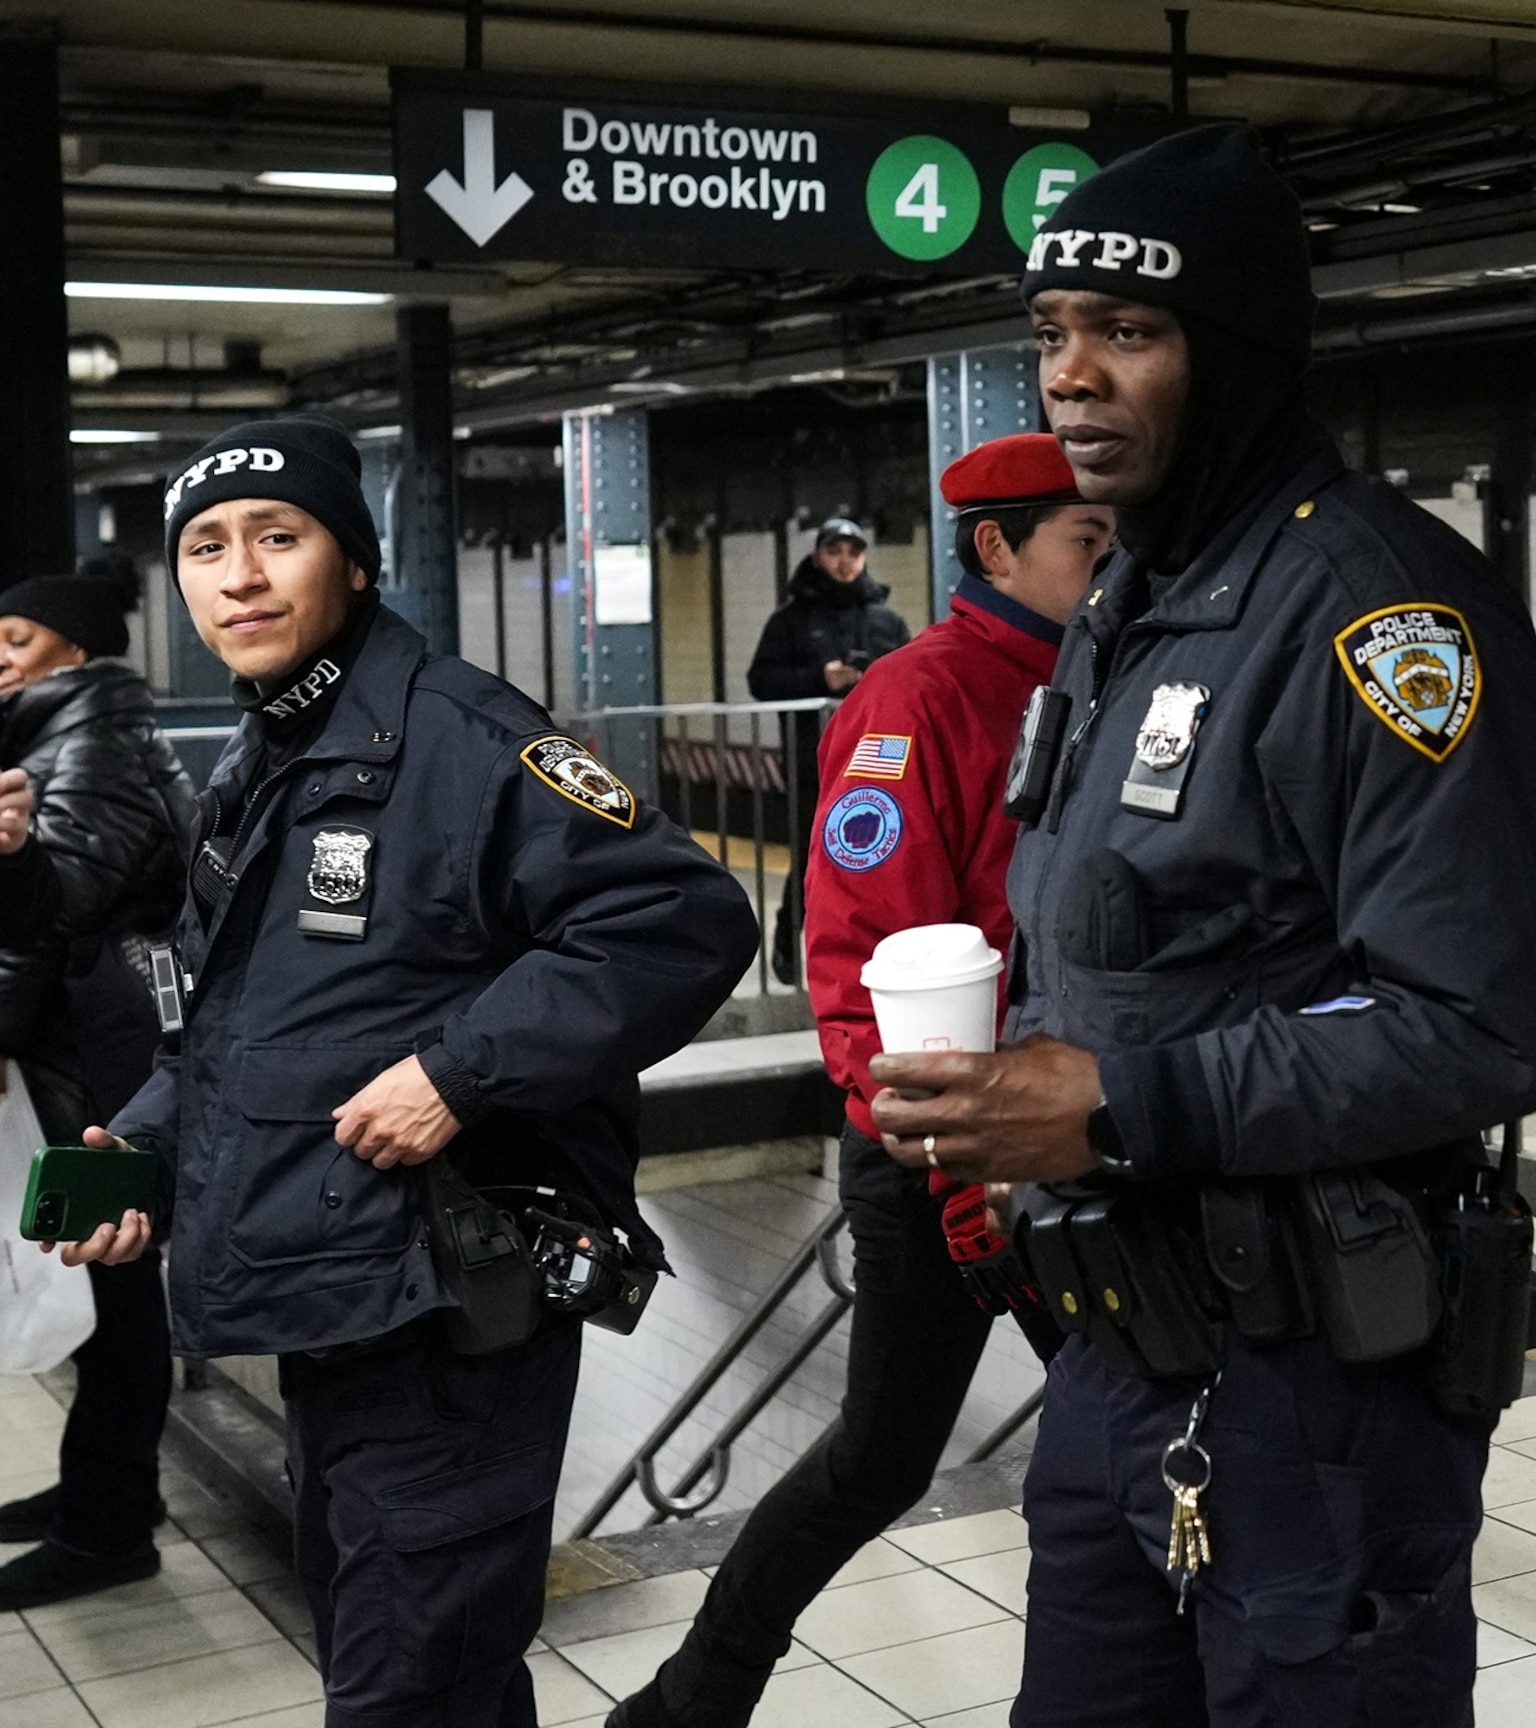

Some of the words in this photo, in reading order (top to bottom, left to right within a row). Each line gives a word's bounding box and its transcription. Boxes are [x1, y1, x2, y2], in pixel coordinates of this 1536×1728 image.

[563, 107, 818, 163] Downtown
[562, 158, 598, 203] &
[613, 160, 826, 220] Brooklyn
[895, 163, 947, 233] 4
[1031, 168, 1077, 232] 5
[1026, 229, 1183, 280] NYPD
[164, 447, 285, 520] NYPD
[1354, 626, 1462, 666] DEPARTMENT
[1370, 612, 1436, 639] POLICE
[262, 658, 341, 719] NYPD
[1364, 680, 1400, 716] CITY
[1397, 715, 1423, 738] OF
[1444, 700, 1468, 738] NEW
[1460, 654, 1475, 699] YORK
[560, 781, 590, 800] CITY
[841, 791, 892, 815] Guillermo
